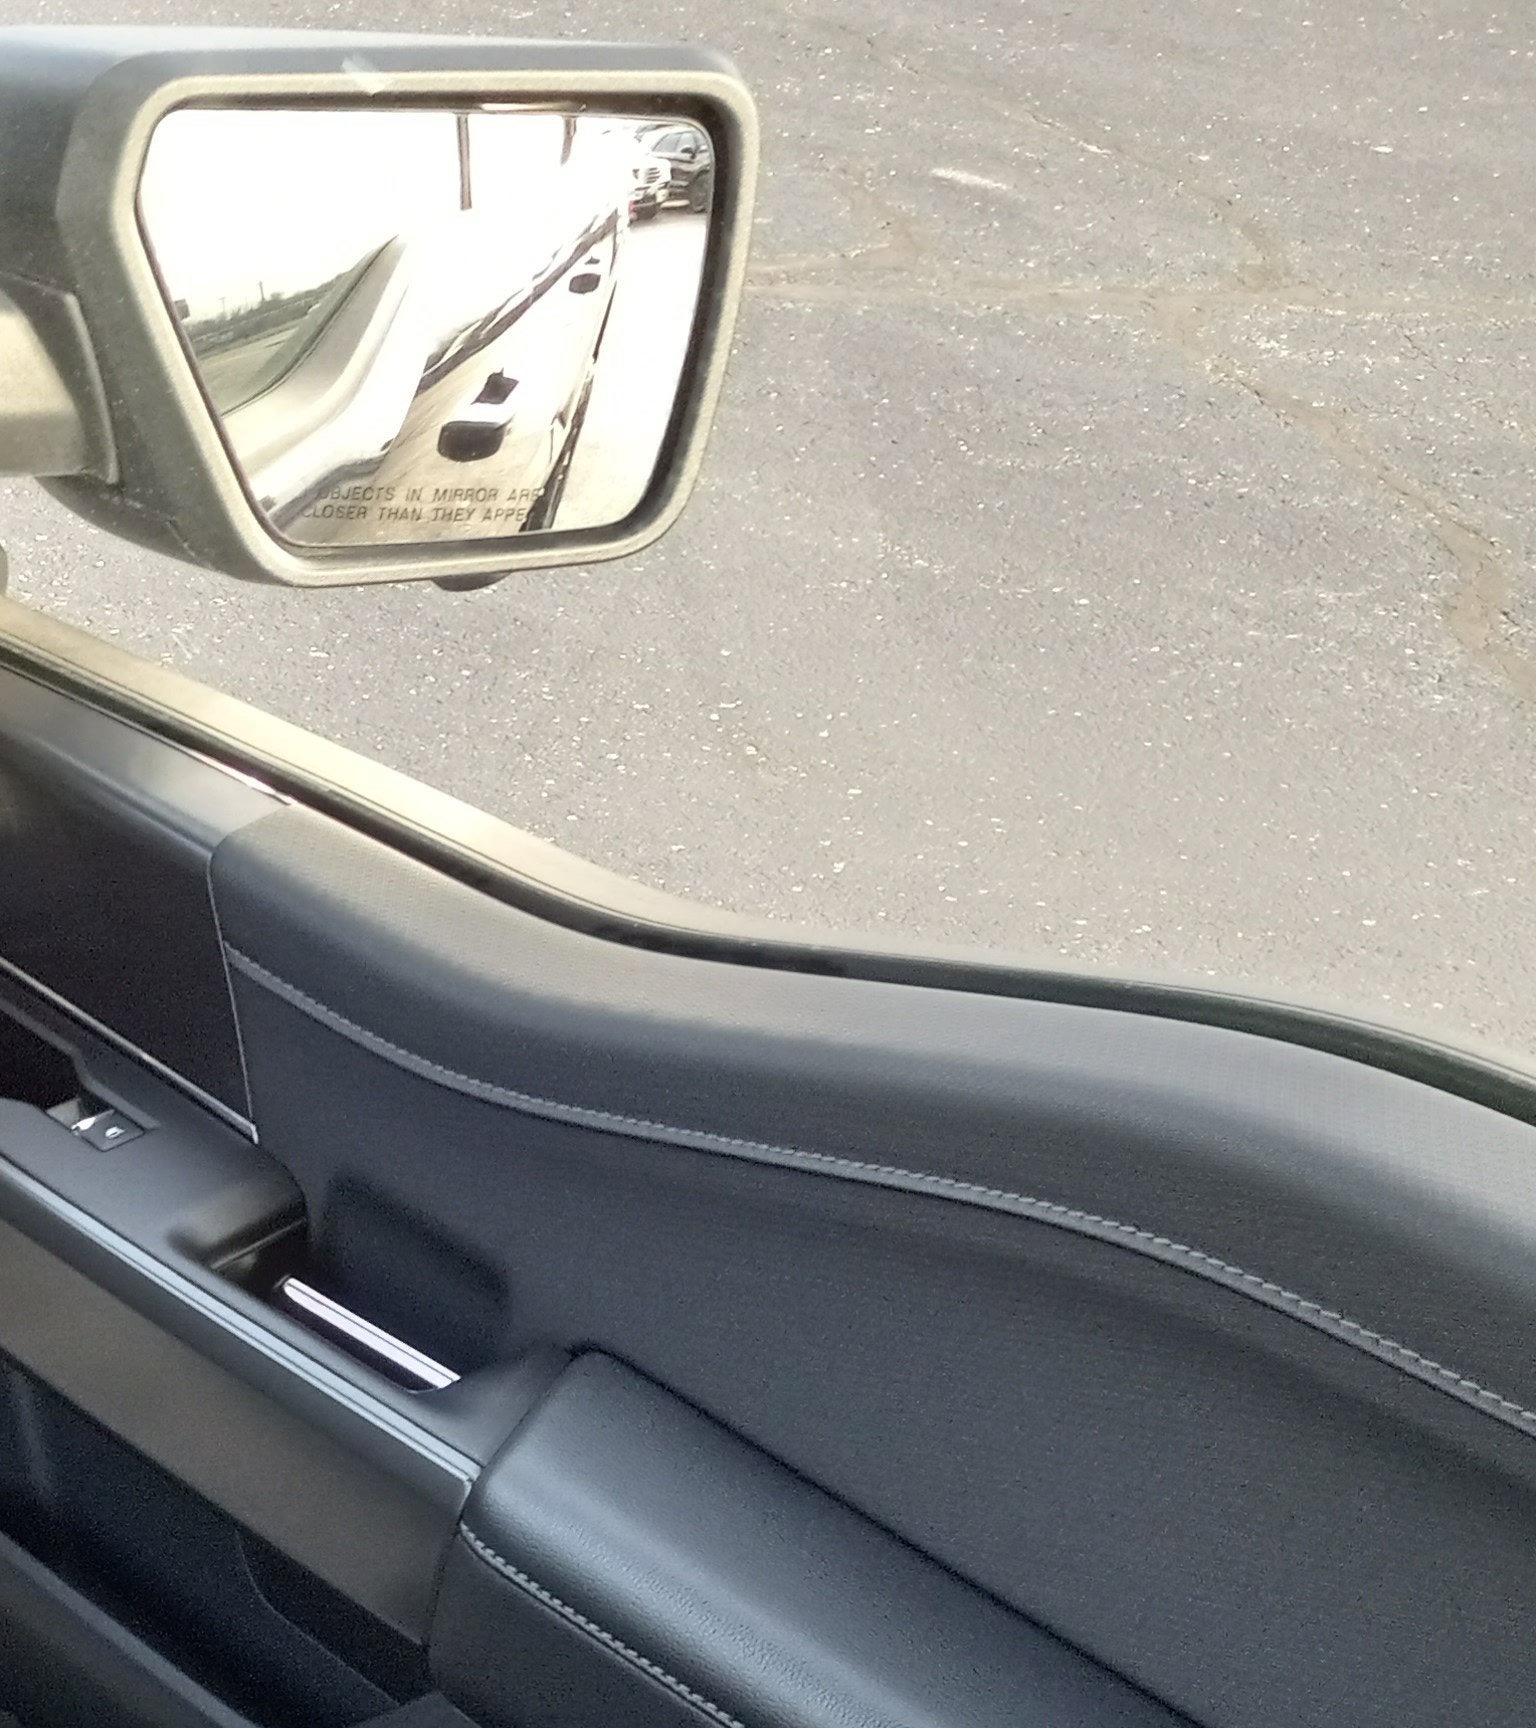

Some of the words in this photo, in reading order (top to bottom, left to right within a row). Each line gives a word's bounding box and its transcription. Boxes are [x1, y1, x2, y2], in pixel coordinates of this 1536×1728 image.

[315, 486, 395, 501] OBJECTS
[405, 486, 422, 500] IN
[432, 486, 498, 502] MIRROR
[507, 487, 540, 502] ARE
[303, 505, 367, 520] CLOSER
[378, 507, 422, 521] THAN
[432, 507, 476, 521] THEY
[482, 507, 528, 522] APPE
